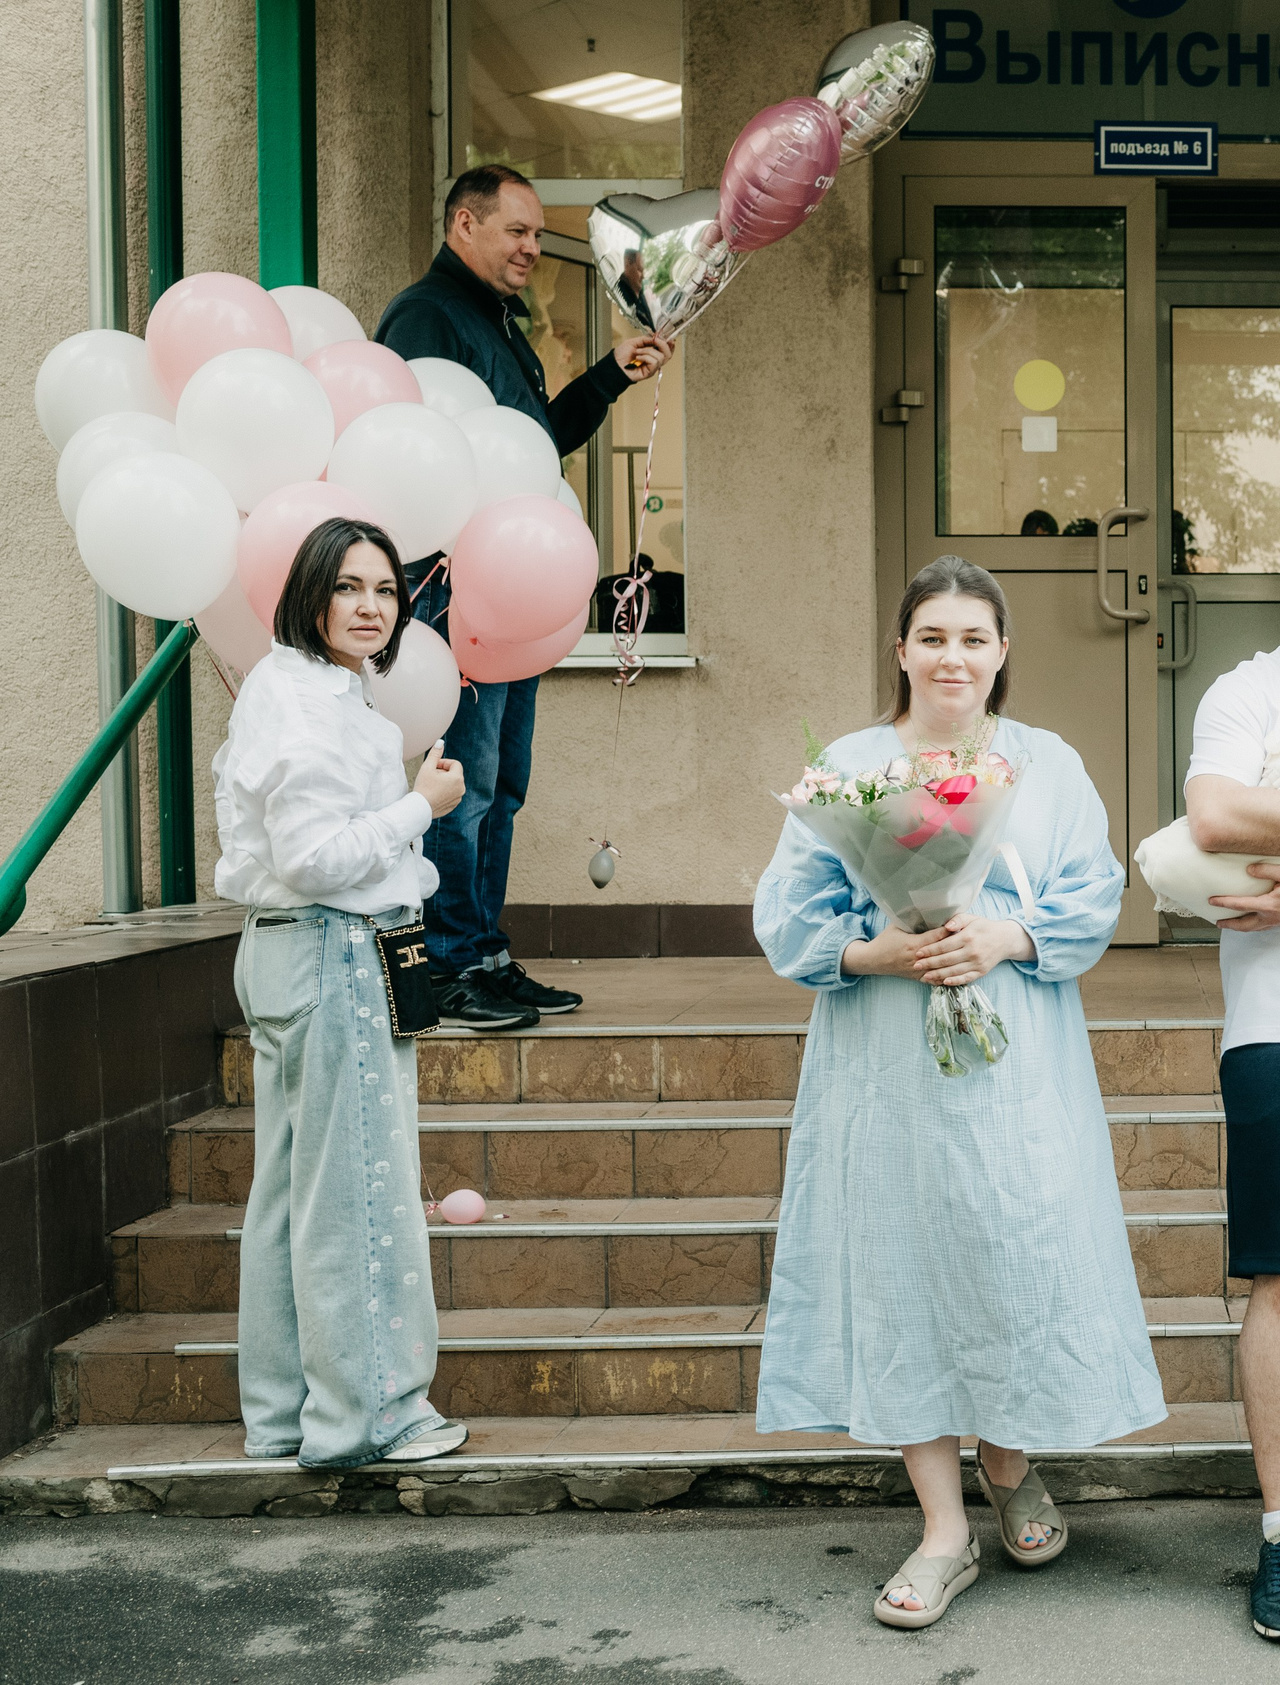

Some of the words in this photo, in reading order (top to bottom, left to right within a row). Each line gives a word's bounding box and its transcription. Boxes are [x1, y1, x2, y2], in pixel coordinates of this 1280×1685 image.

[1110, 142, 1170, 156] подъезд
[1173, 140, 1189, 154] №
[1193, 141, 1202, 155] 6
